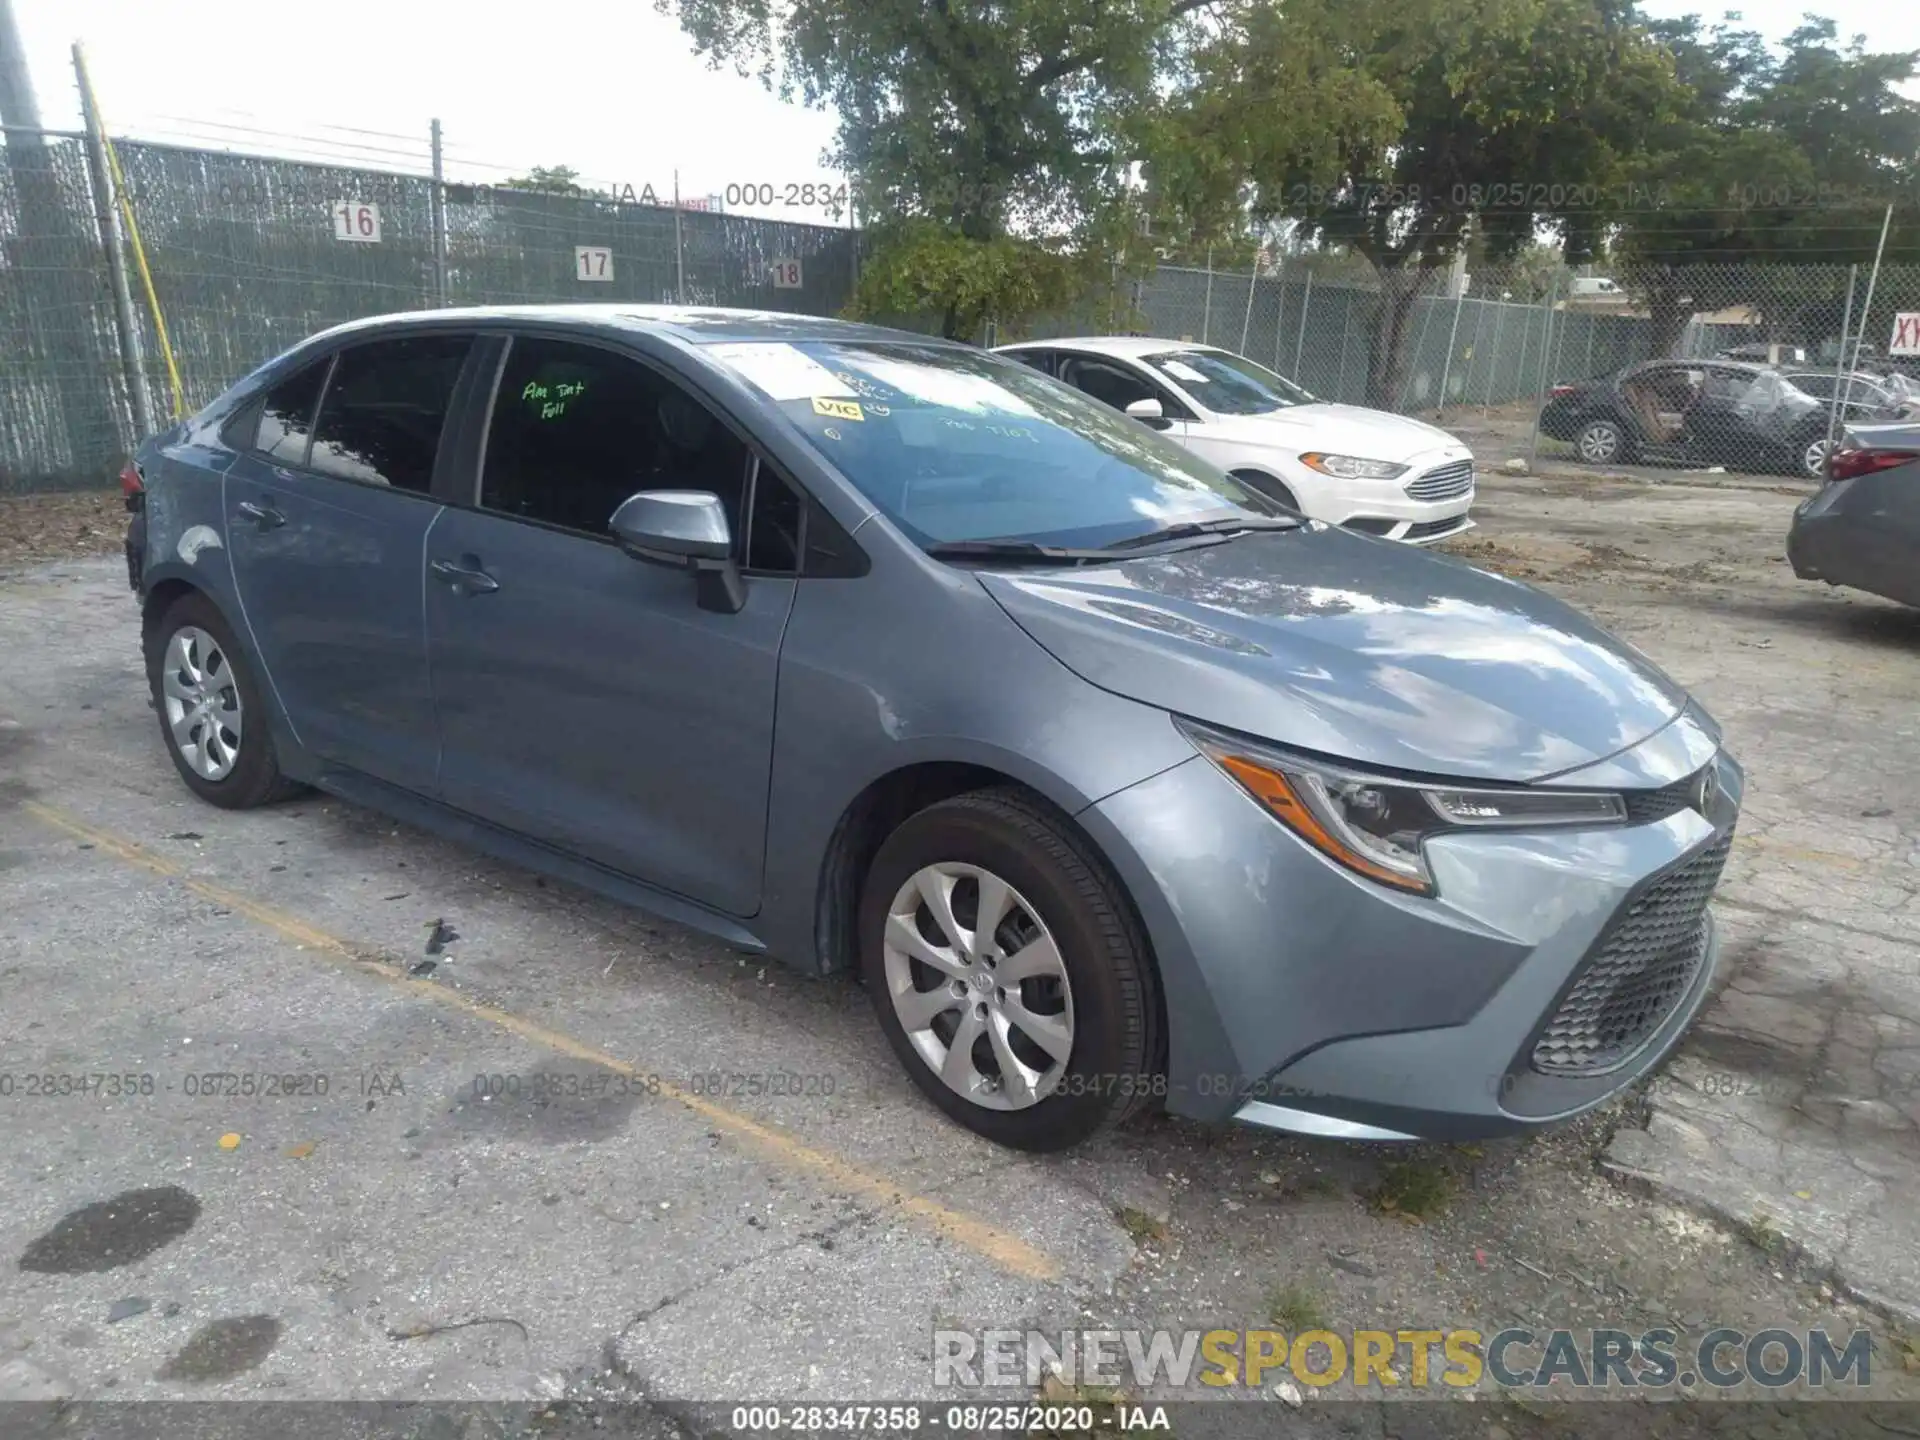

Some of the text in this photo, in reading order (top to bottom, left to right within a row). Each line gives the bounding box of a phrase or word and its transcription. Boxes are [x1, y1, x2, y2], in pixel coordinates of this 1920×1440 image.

[338, 206, 373, 237] 16
[579, 252, 608, 276] 17
[775, 263, 800, 285] 18
